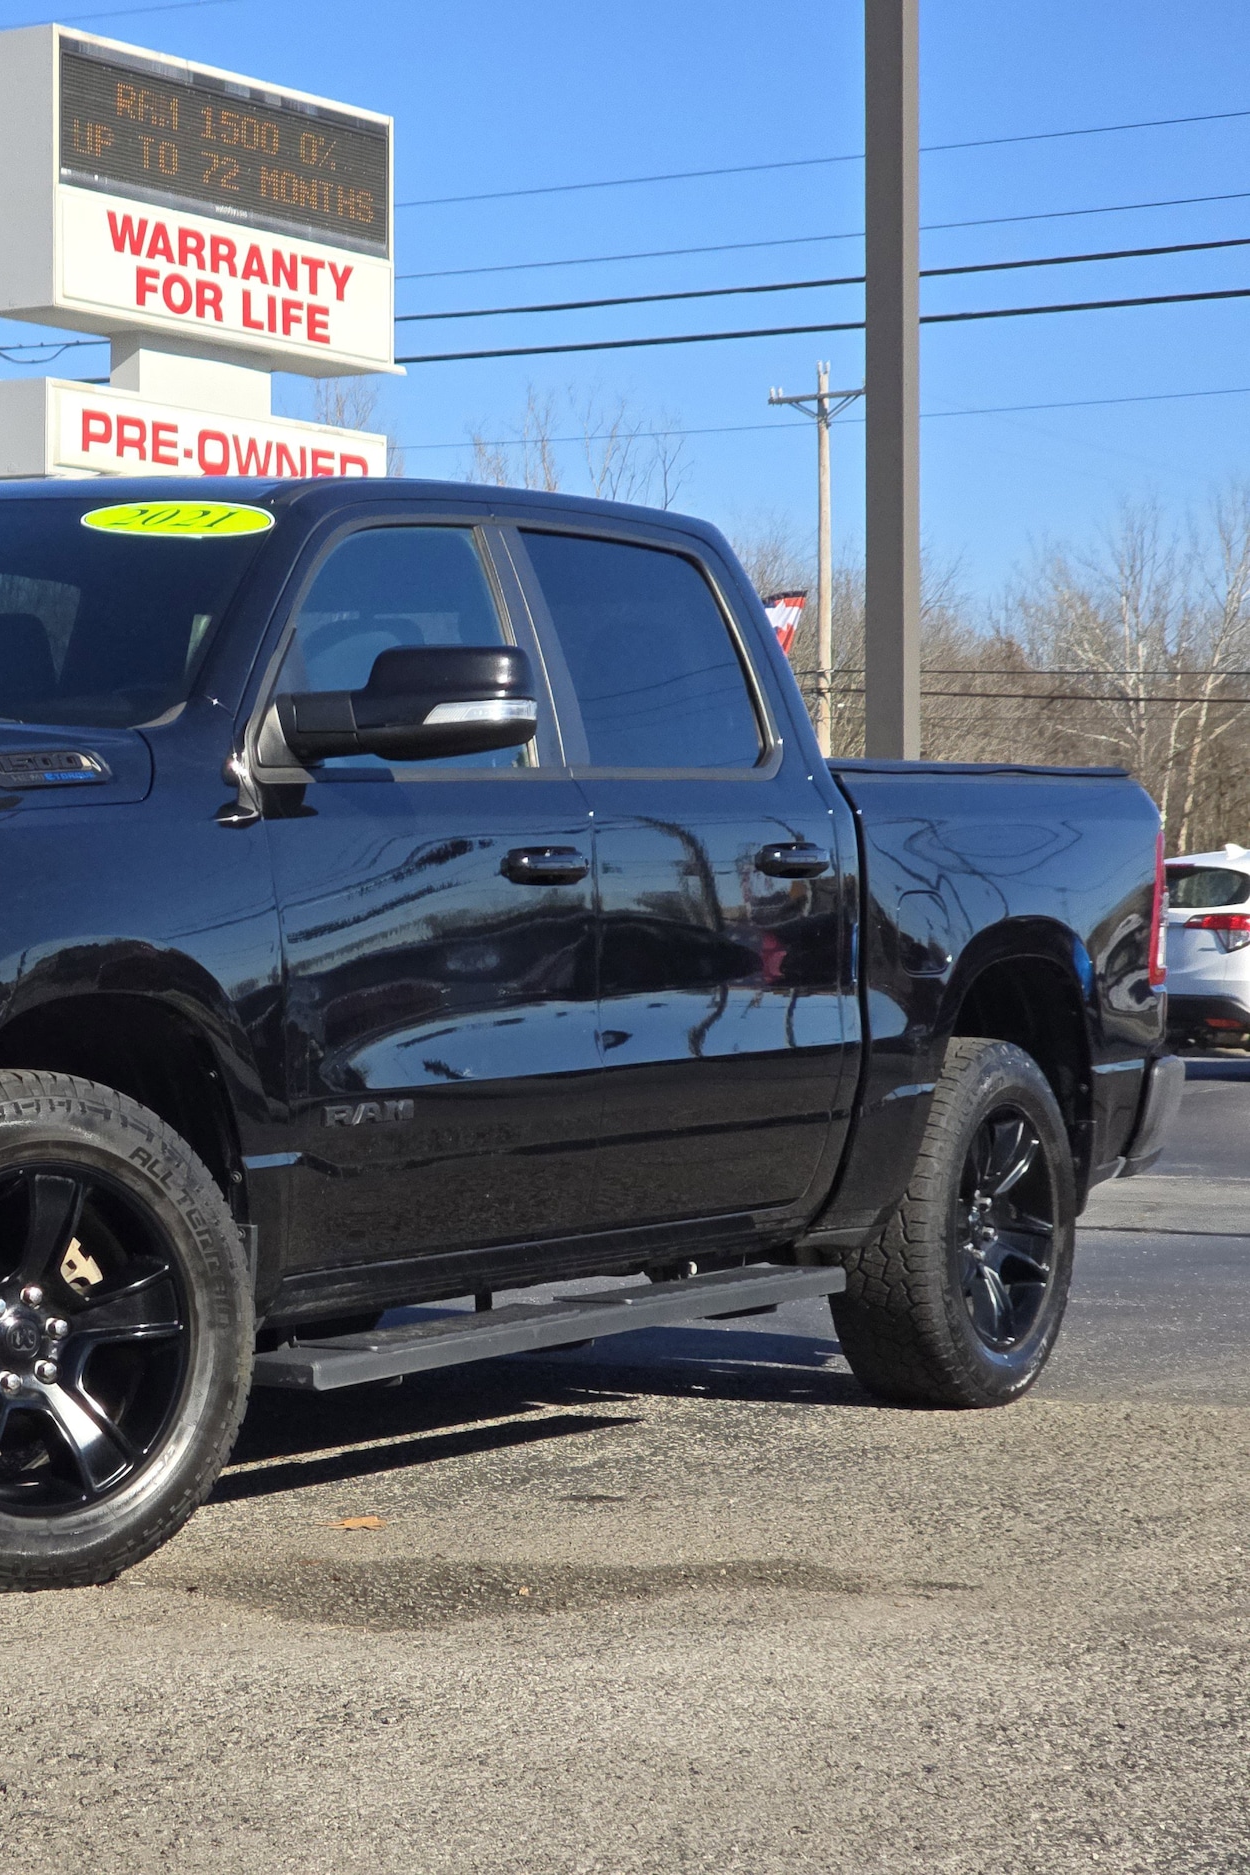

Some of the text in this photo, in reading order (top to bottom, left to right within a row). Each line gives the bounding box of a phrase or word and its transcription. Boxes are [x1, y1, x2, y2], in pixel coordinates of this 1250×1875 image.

[200, 106, 280, 156] 1500
[72, 118, 374, 223] UP TO 72 MONTHS
[106, 209, 354, 302] WARRANTY
[136, 265, 331, 345] FOR LIFE
[106, 507, 238, 528] 2021
[321, 1099, 415, 1128] RAM
[128, 1146, 175, 1192] ALL
